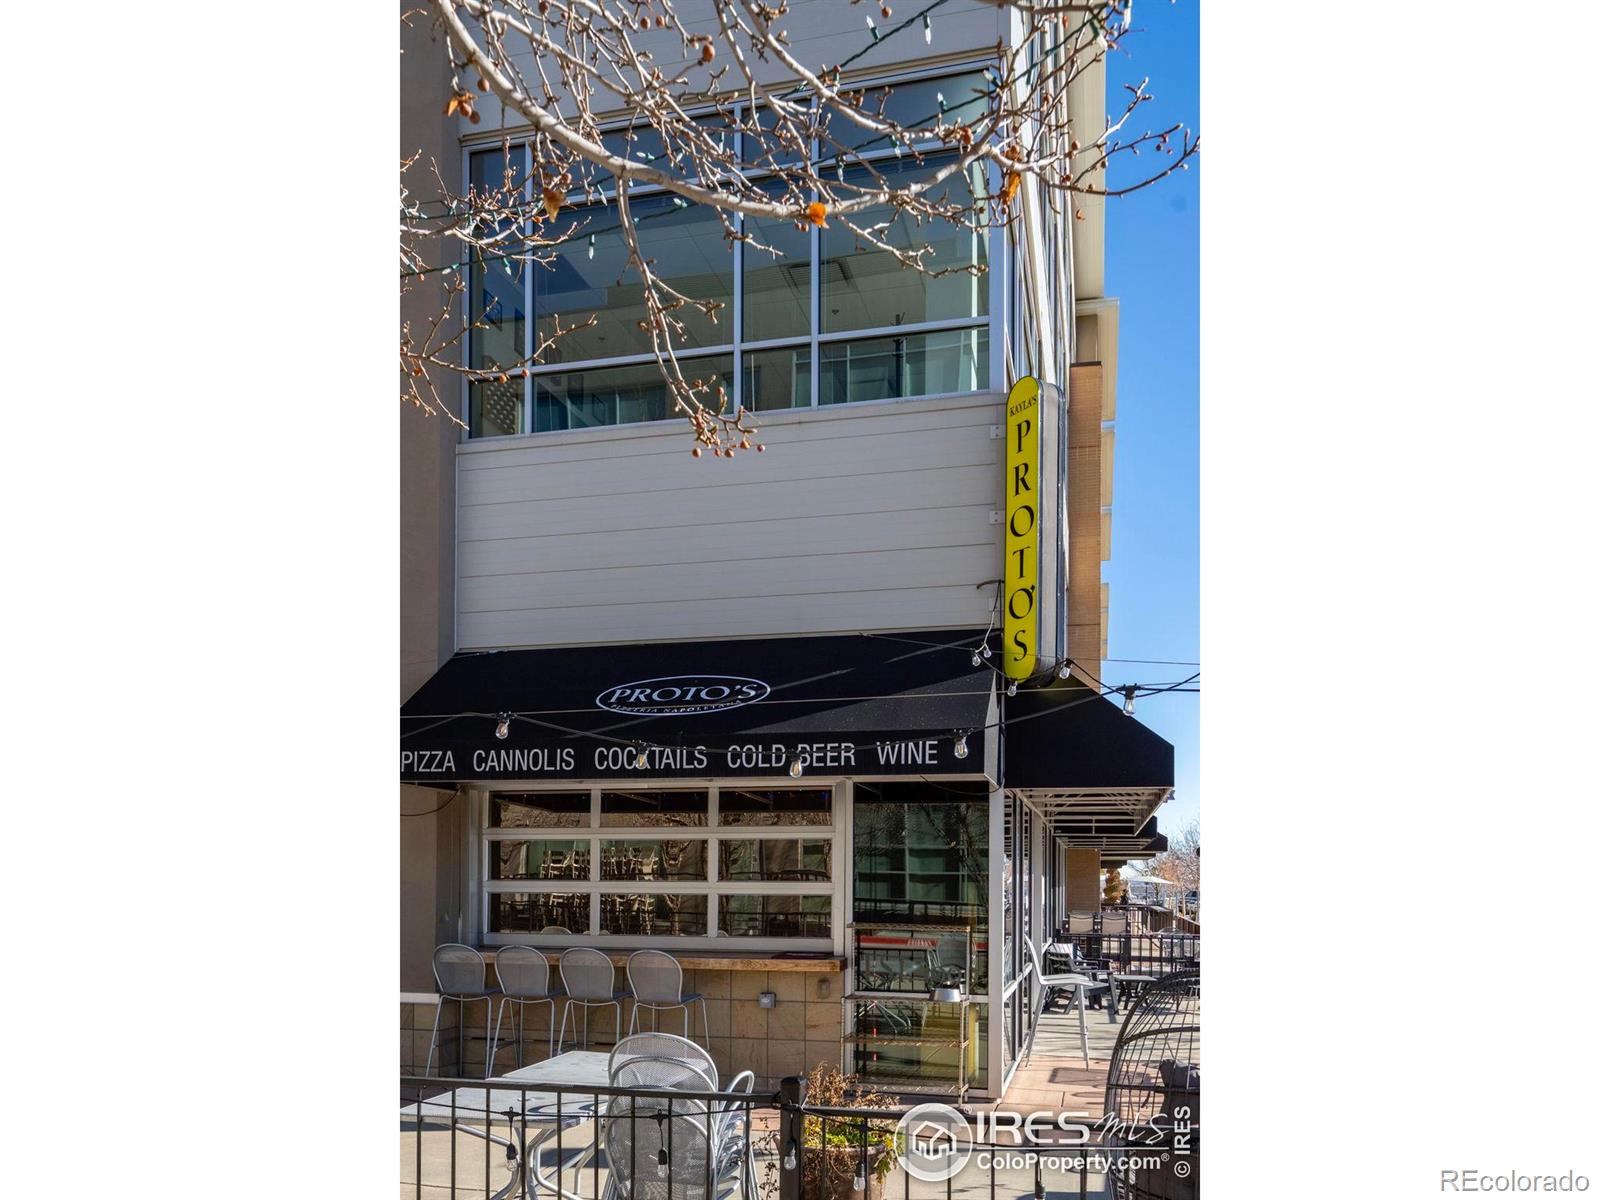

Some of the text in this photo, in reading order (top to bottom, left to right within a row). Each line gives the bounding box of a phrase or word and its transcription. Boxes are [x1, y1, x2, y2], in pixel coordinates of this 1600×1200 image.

[1009, 393, 1038, 417] KAYLA'S
[1009, 419, 1036, 662] PROTO'S
[607, 684, 758, 703] PROTO'S
[400, 750, 456, 773] PIZZA
[472, 748, 575, 772] CANNOLIS
[727, 744, 786, 769] COLD
[875, 740, 939, 766] WINE
